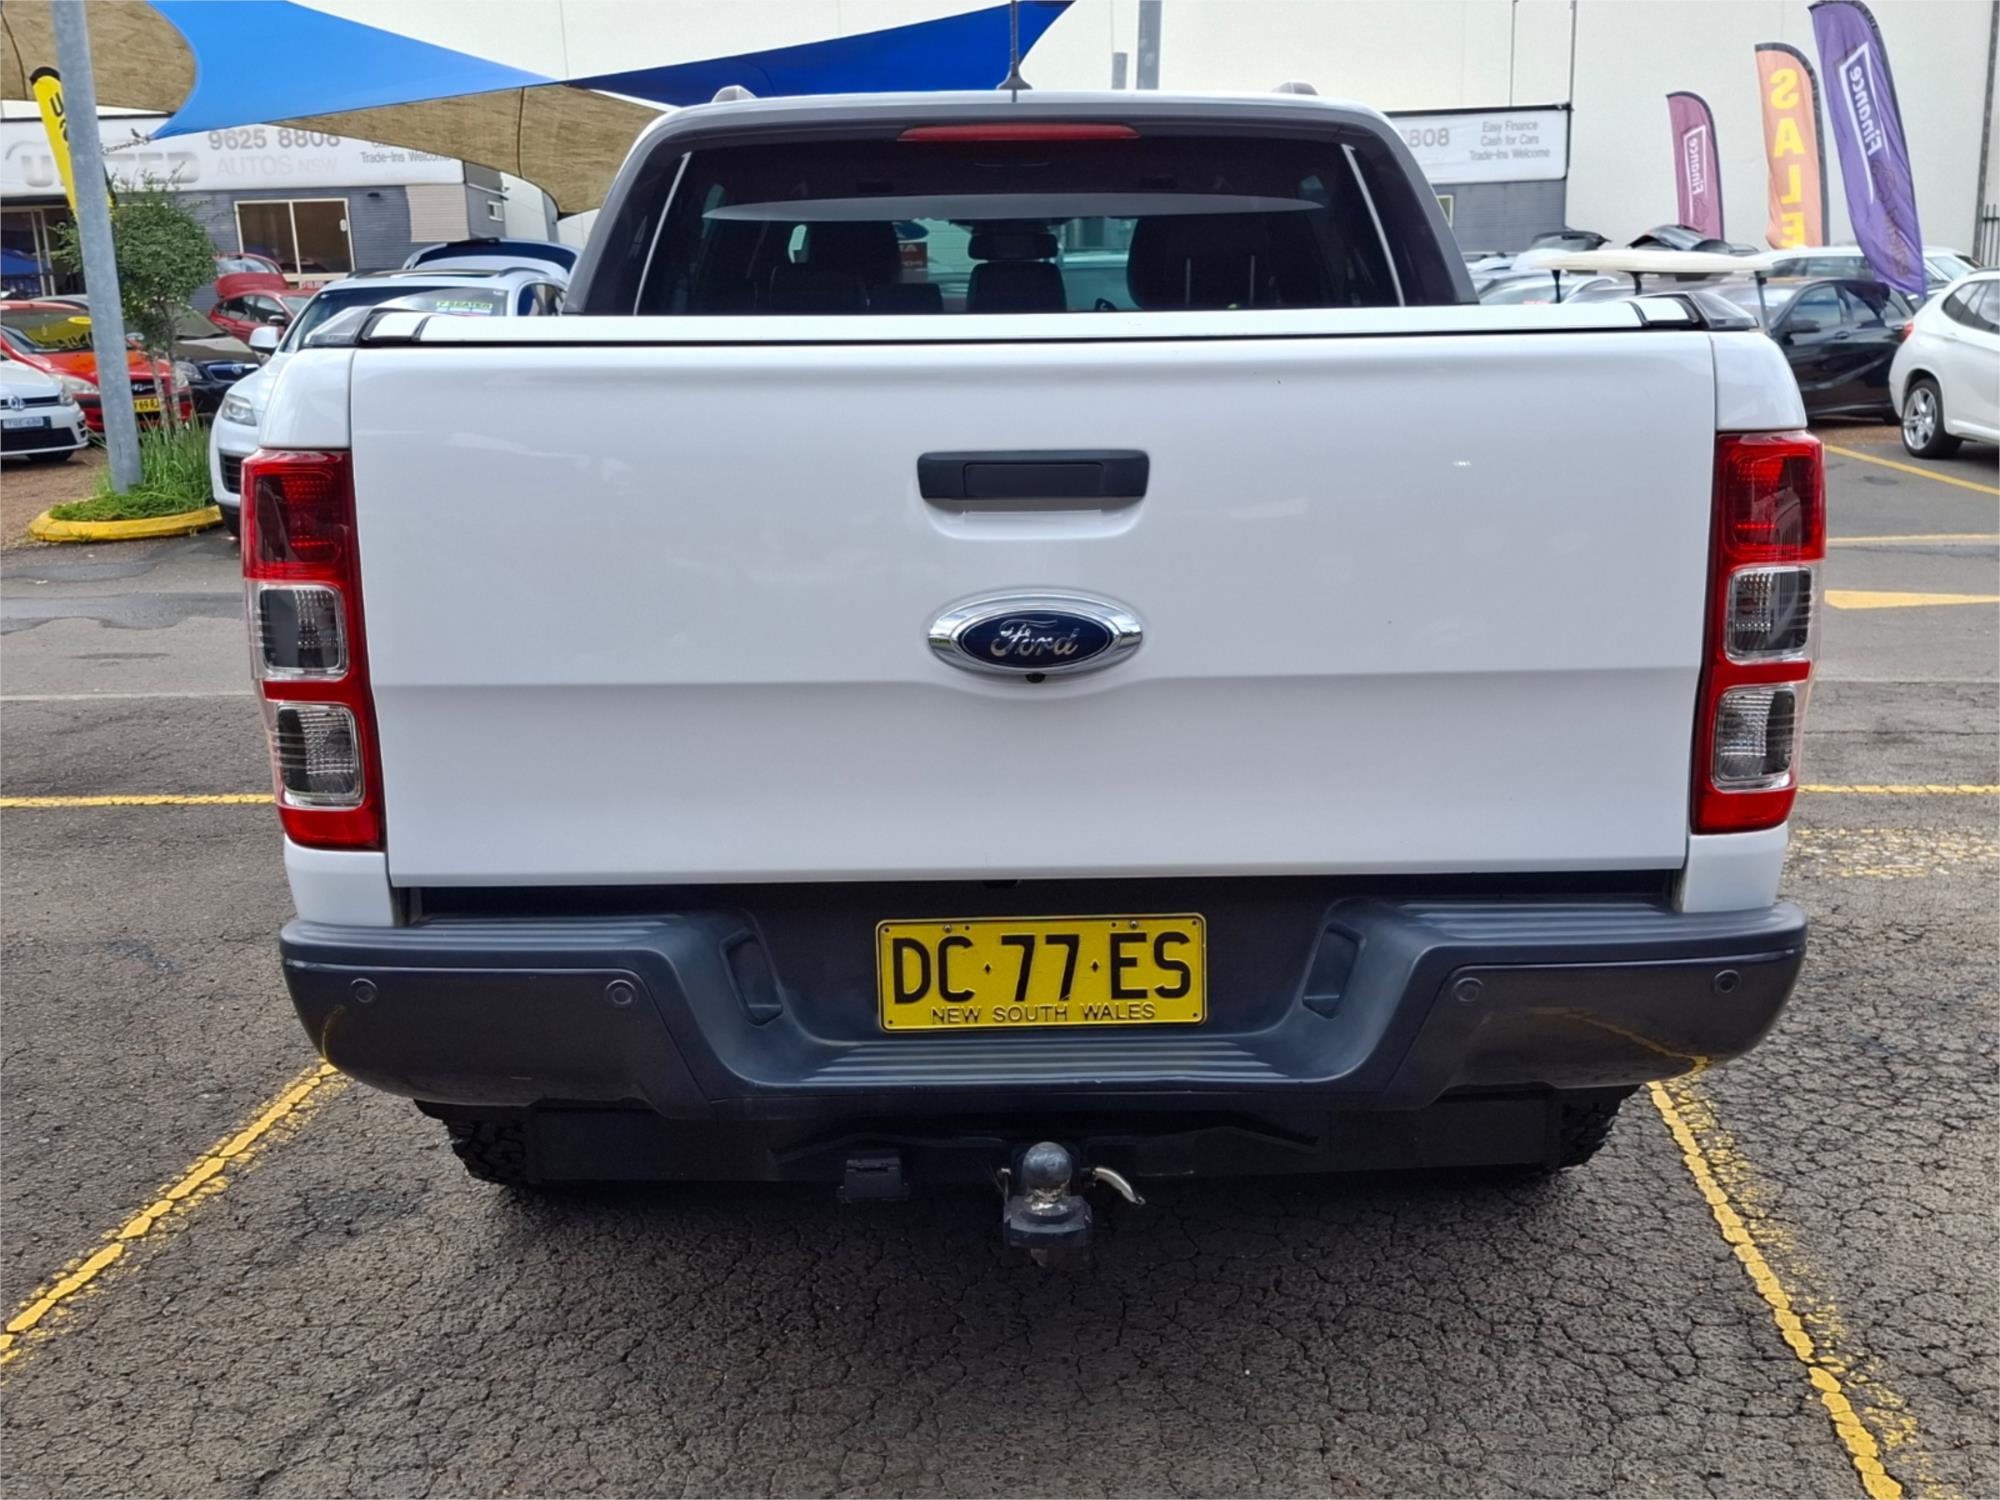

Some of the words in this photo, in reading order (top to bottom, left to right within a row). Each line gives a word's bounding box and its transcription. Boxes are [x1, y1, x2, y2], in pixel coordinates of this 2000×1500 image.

[1482, 121, 1502, 133] Easy
[1505, 120, 1538, 131] Finance
[208, 129, 267, 150] 9625
[277, 128, 341, 148] 8808
[1400, 128, 1450, 148] 808
[1480, 135, 1501, 147] Cash
[1505, 135, 1517, 145] for
[1519, 134, 1539, 145] Cars
[216, 154, 294, 177] AUTOS
[298, 158, 339, 175] NSW
[360, 151, 405, 163] Trade-Ins
[1469, 150, 1509, 161] Trade-Ins
[1512, 149, 1551, 159] Welcome
[990, 618, 1080, 657] Ford
[891, 935, 976, 1005] DC
[1000, 933, 1081, 1002] 77
[1109, 931, 1192, 1000] ES
[931, 1006, 982, 1025] NEW
[992, 1004, 1068, 1023] SOUTH
[1081, 1002, 1156, 1021] WALES
